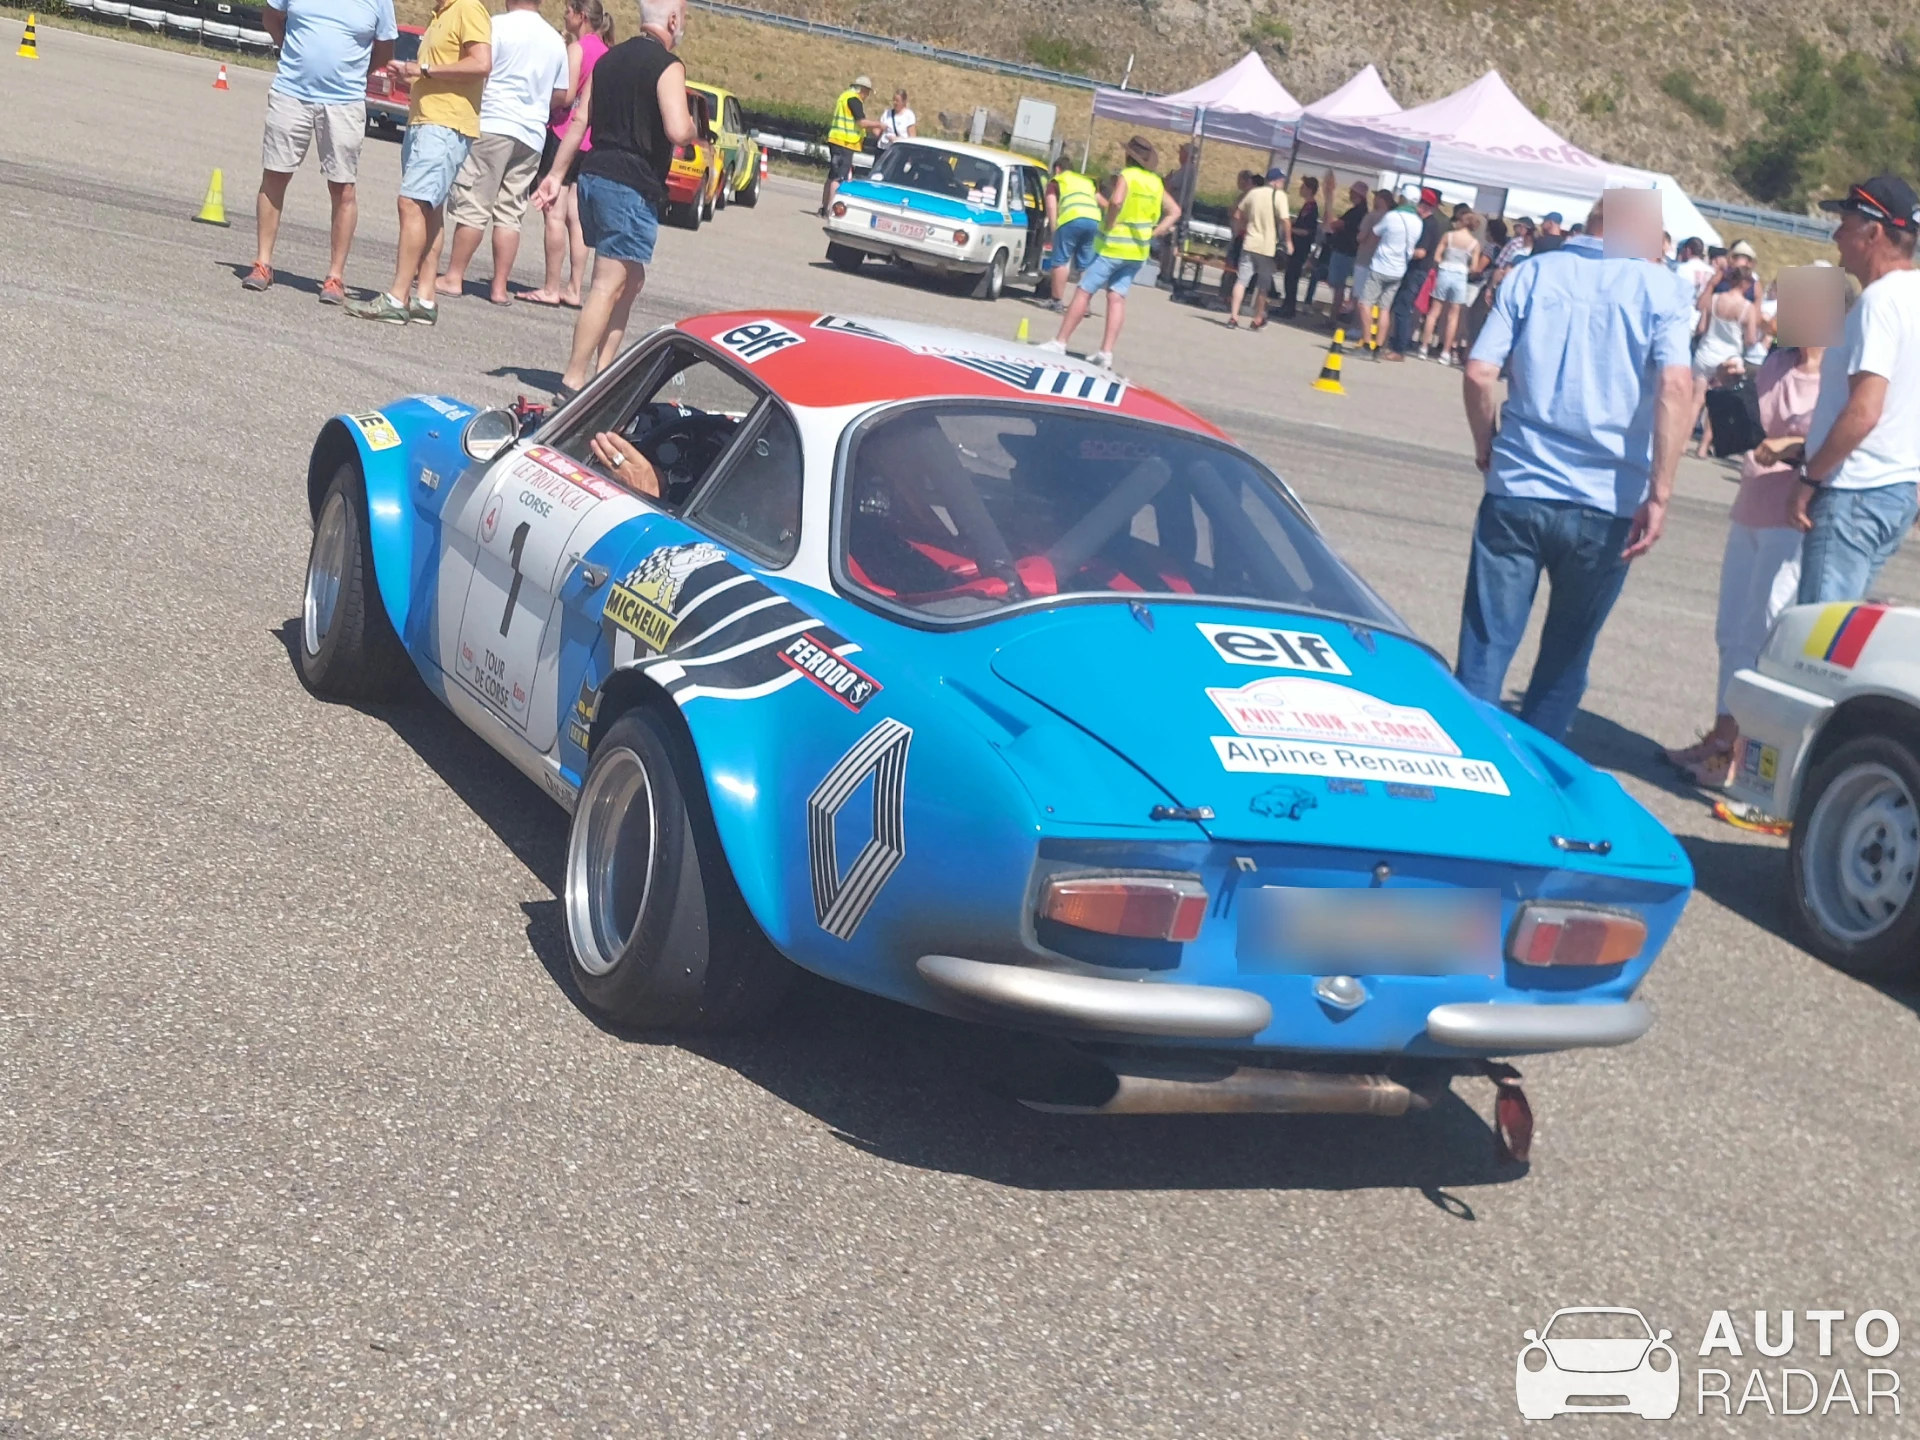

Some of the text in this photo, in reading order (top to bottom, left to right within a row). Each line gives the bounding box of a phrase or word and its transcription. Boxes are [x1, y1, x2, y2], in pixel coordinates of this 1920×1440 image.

[723, 324, 799, 358] elf
[513, 461, 535, 481] LE
[486, 508, 496, 529] 4
[519, 490, 553, 518] CORSE
[500, 521, 530, 638] 1
[605, 591, 671, 646] MICHELIN
[485, 649, 505, 680] TOUR
[785, 638, 858, 694] FERODO
[1214, 631, 1334, 670] elf
[474, 668, 509, 708] DE CORSE
[1289, 711, 1348, 732] TOUR
[1371, 720, 1436, 741] CORSE
[1228, 741, 1496, 784] Alpine Renault elf
